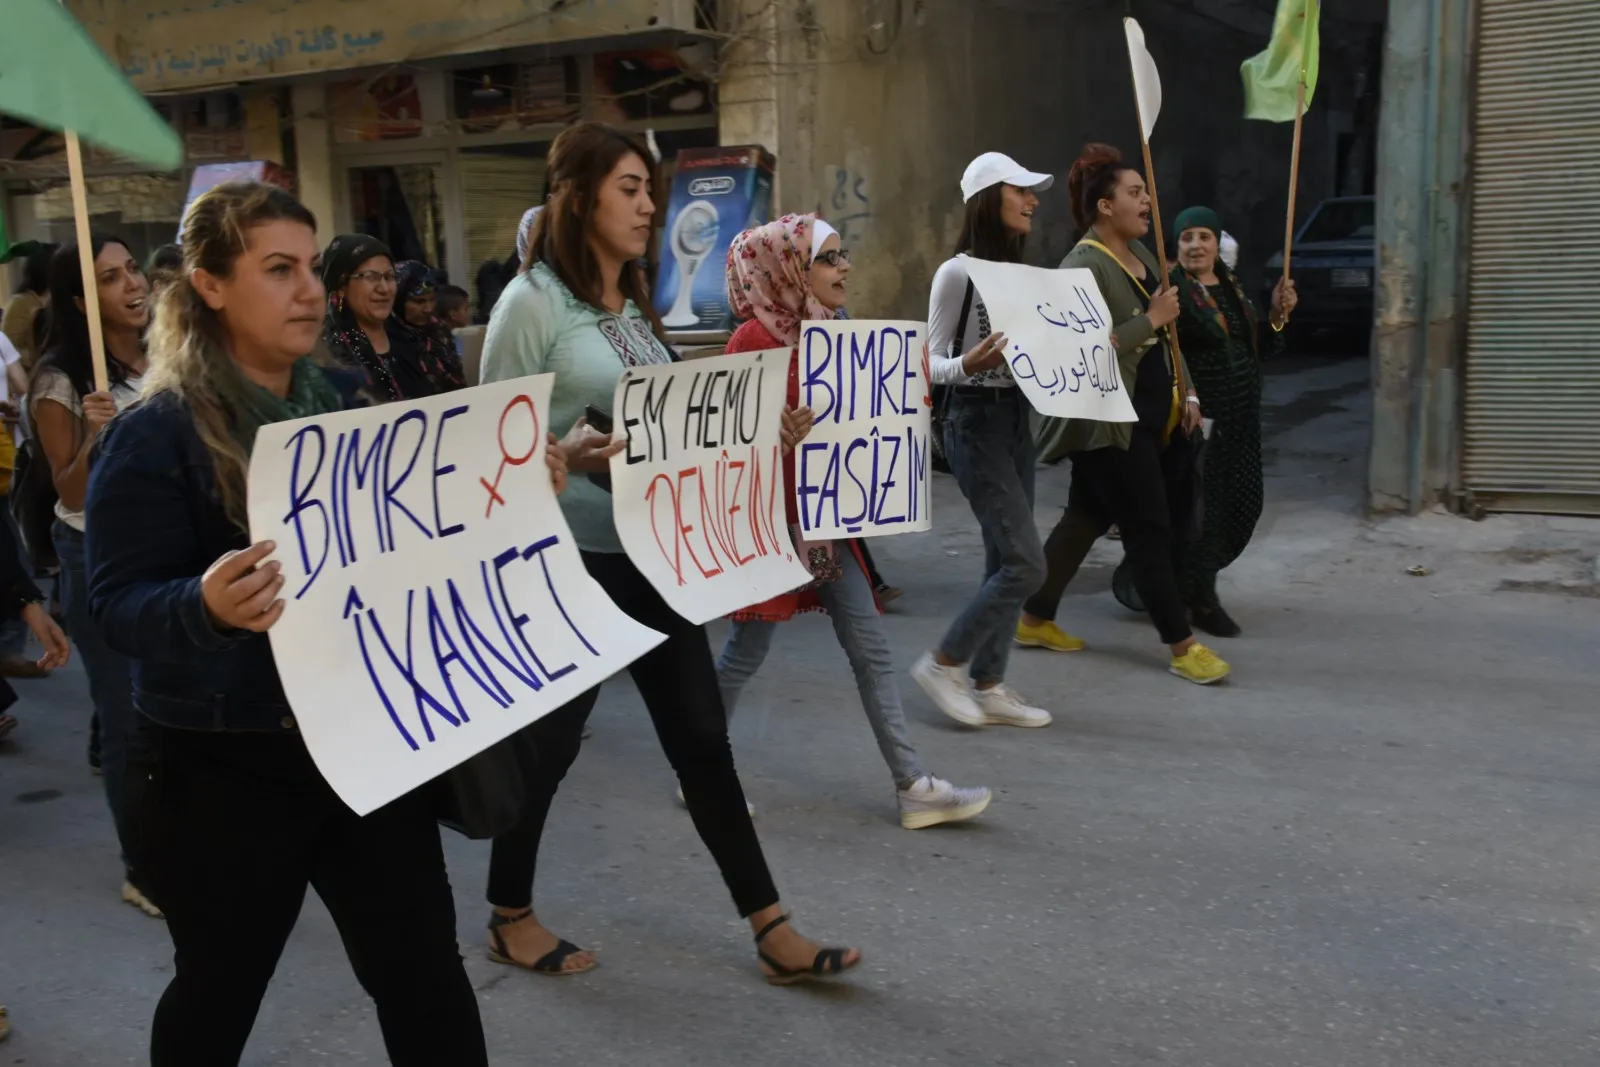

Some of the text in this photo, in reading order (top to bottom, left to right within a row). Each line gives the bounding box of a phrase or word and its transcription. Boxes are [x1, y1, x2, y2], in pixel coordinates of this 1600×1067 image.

[803, 327, 917, 426] BIMRE
[1036, 284, 1106, 334] الموت
[283, 404, 470, 600] BIMRE
[343, 535, 600, 751] ÎXANET
